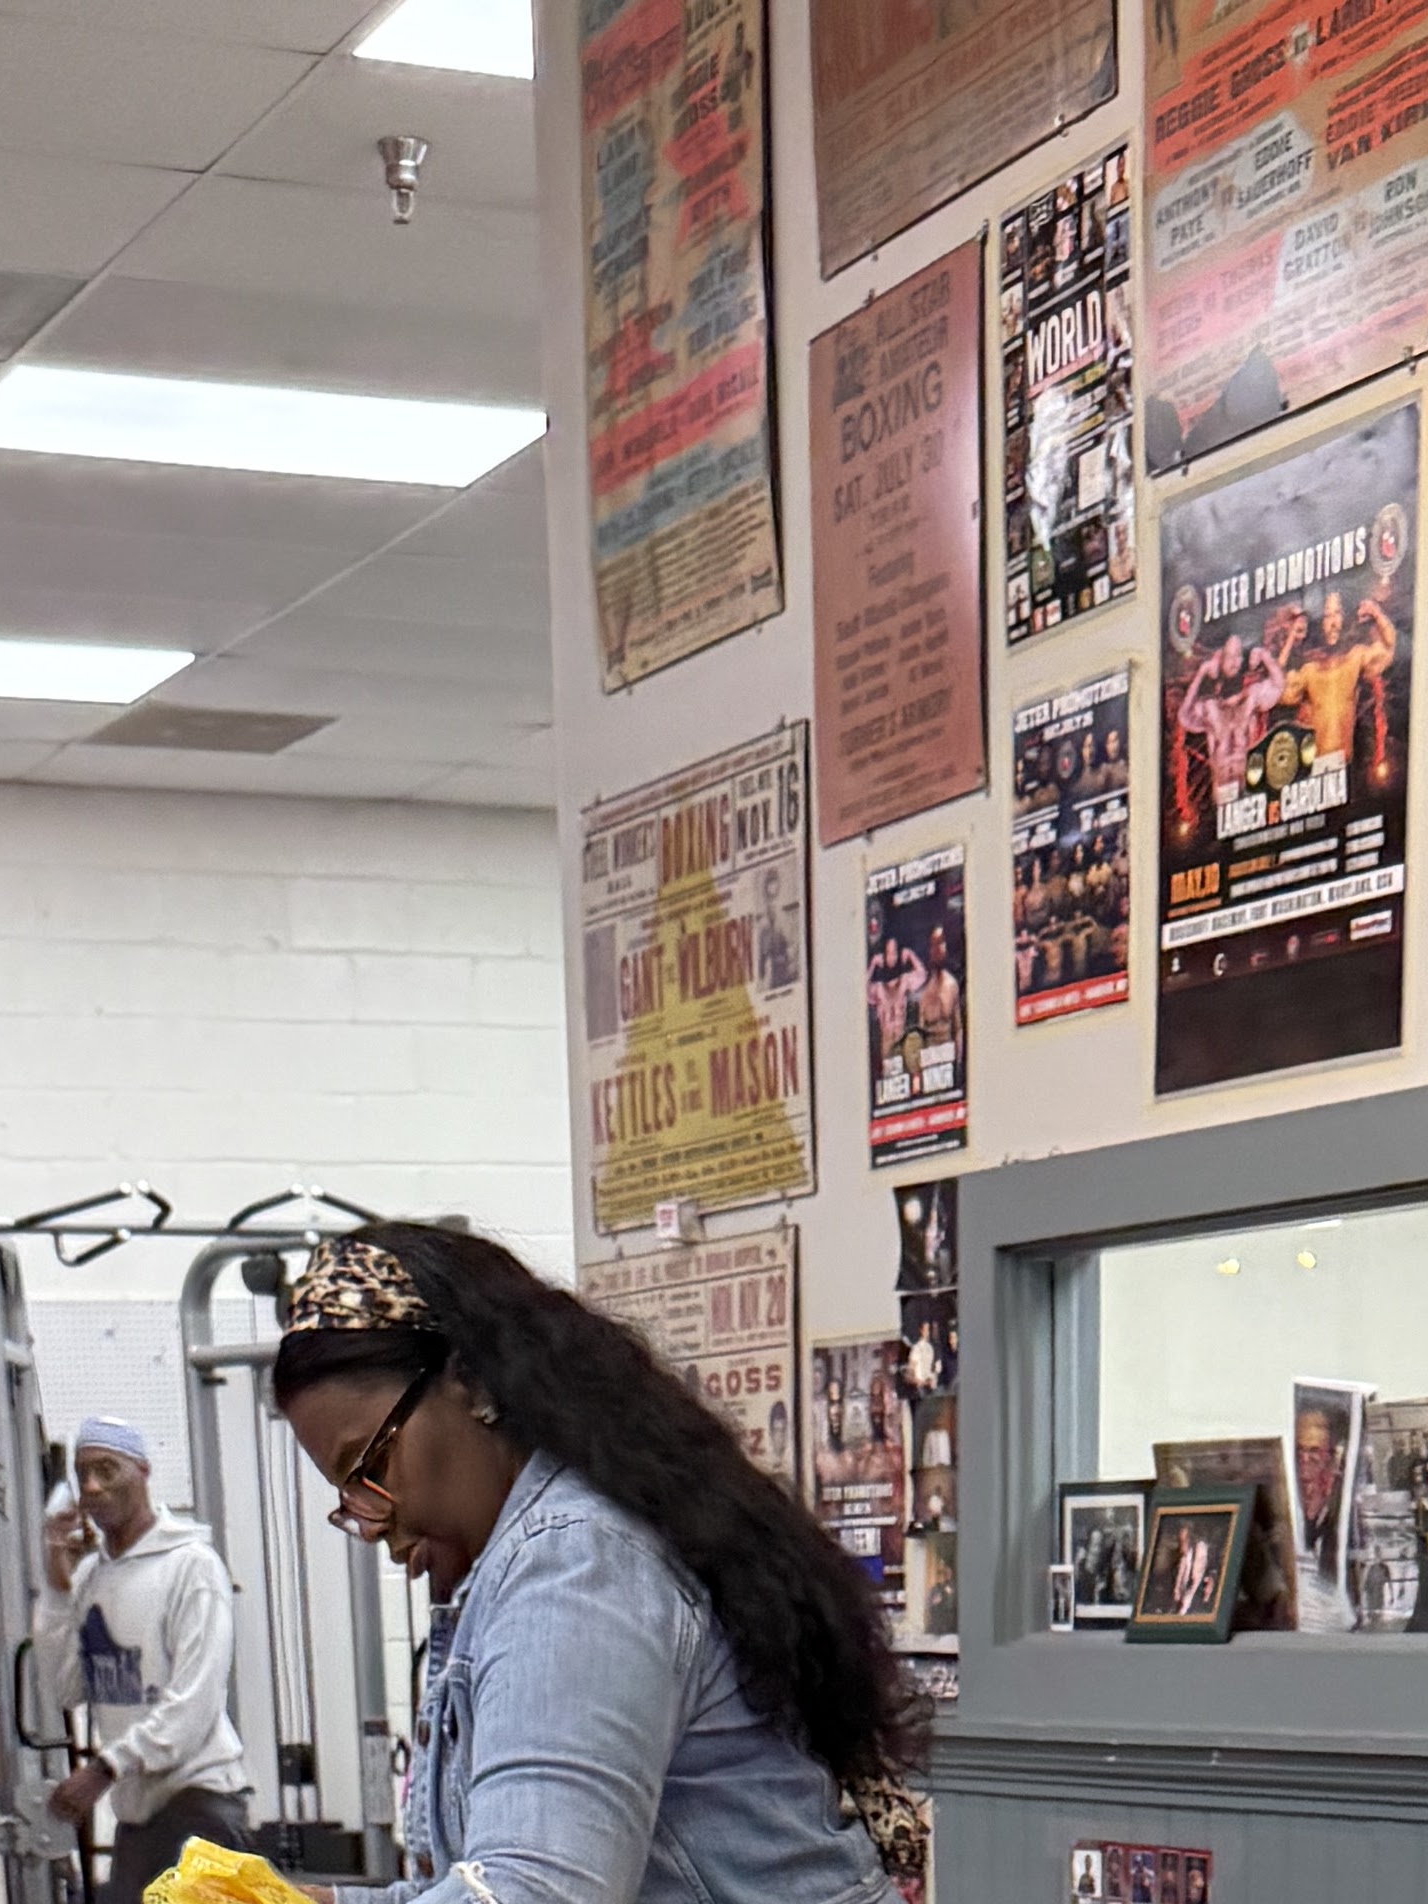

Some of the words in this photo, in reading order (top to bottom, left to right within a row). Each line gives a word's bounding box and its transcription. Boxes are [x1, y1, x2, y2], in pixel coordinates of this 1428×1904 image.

[1027, 290, 1102, 387] WORLD
[841, 360, 943, 464] BOXING
[1204, 573, 1249, 623] JETER
[1255, 526, 1366, 604] PROMOTIONS
[708, 1025, 800, 1120] MASON
[706, 1364, 782, 1397] GOSS
